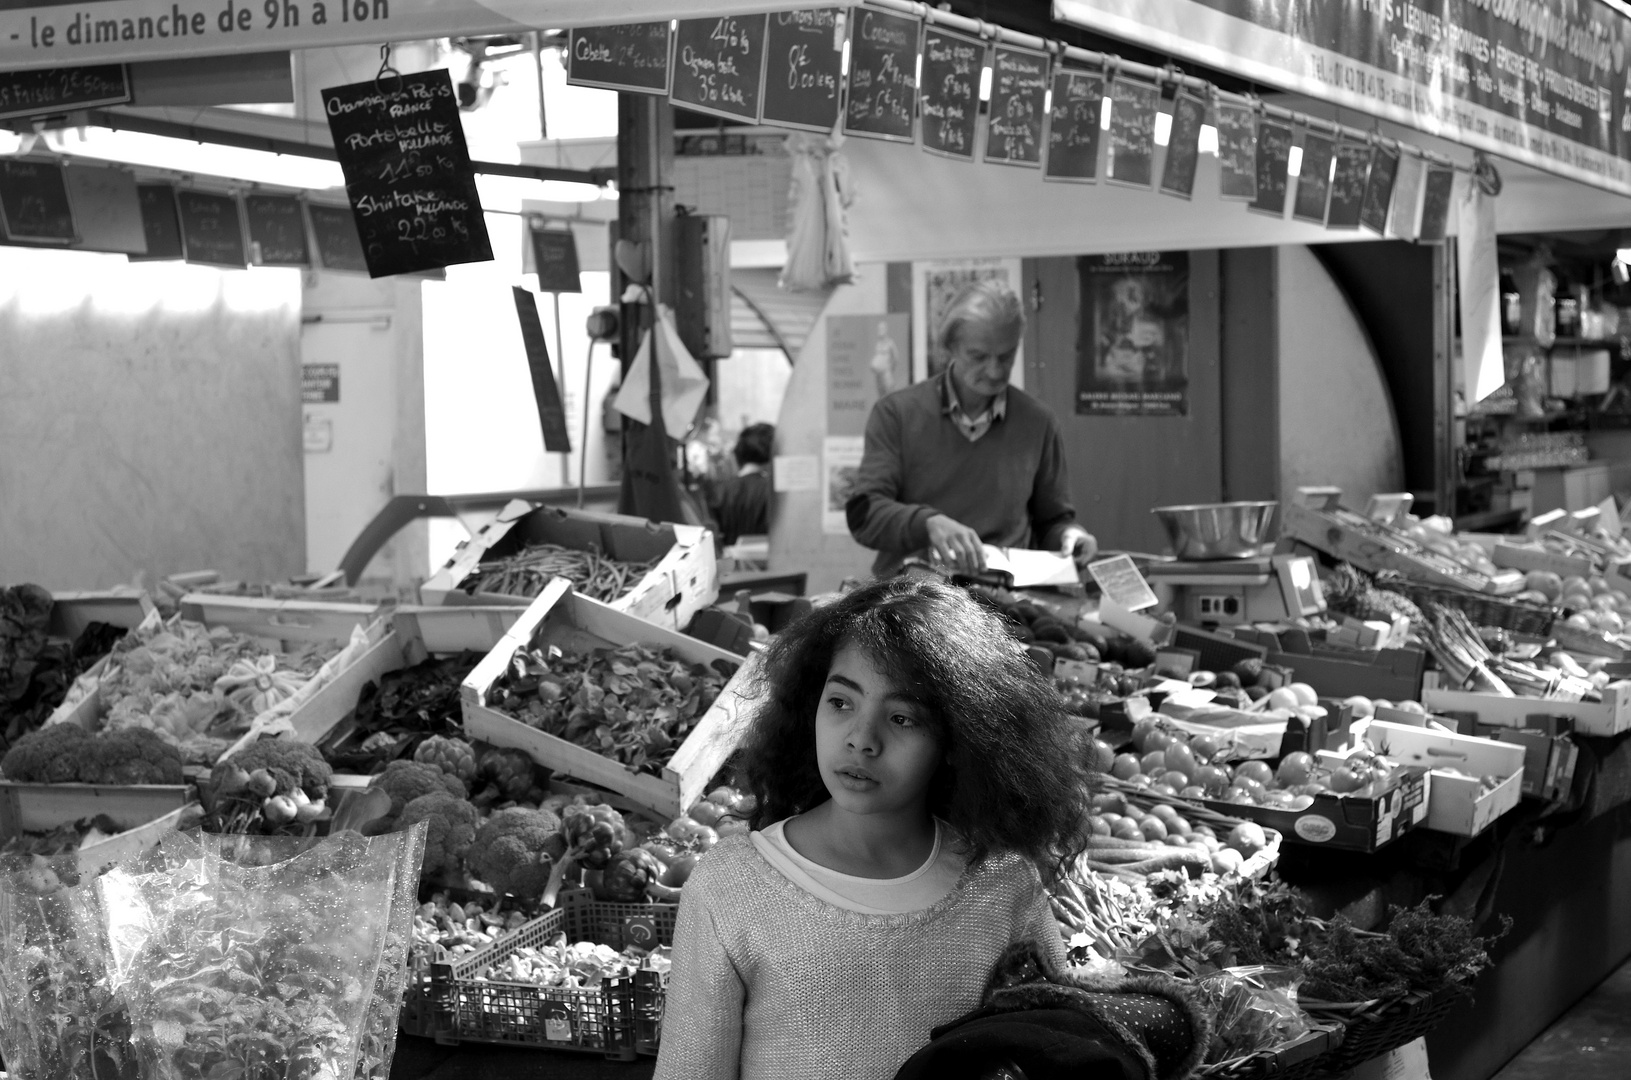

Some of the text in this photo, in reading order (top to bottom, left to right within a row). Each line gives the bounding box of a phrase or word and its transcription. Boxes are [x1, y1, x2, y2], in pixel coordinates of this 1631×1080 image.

[31, 16, 55, 48] le
[66, 3, 206, 46] dimanche
[217, 0, 252, 33] de
[264, 0, 299, 29] 9h
[356, 190, 440, 217] Shiitake
